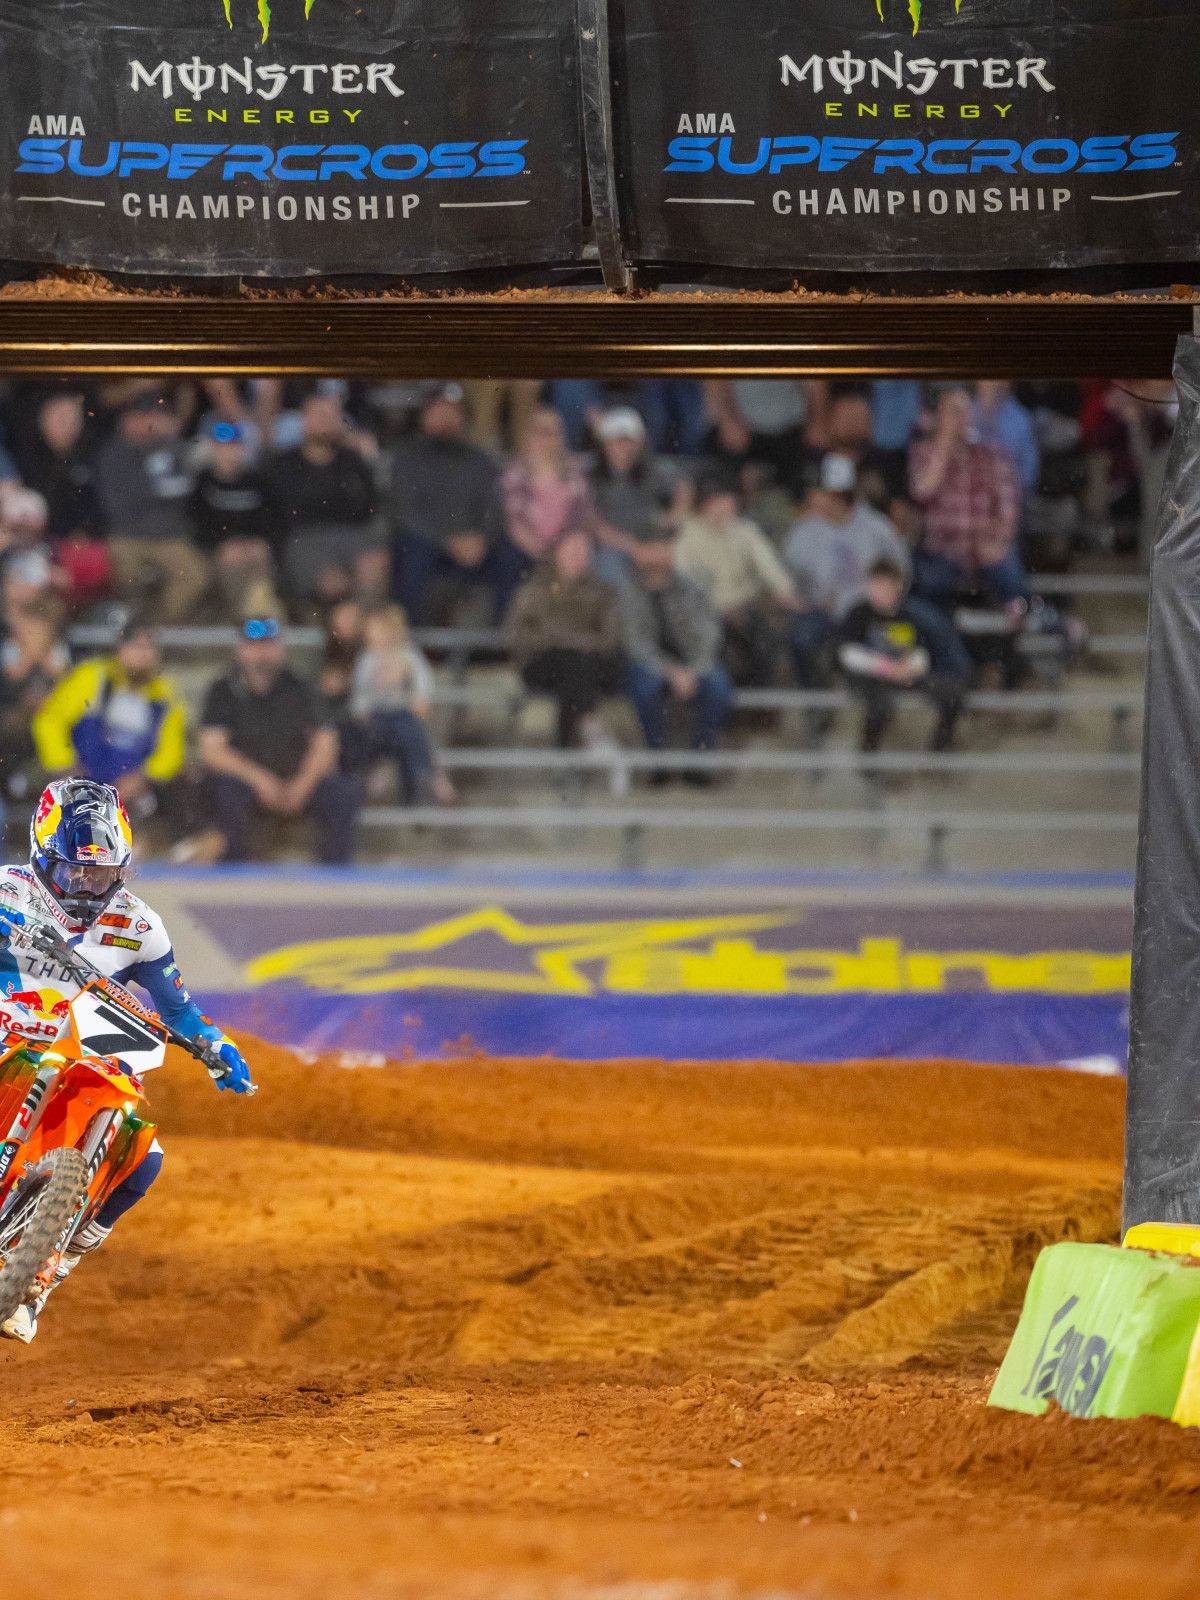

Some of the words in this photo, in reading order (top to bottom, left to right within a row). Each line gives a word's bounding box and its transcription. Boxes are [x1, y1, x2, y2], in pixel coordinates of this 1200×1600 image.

[129, 55, 405, 102] MONSTER
[778, 49, 1056, 95] MONSTER
[27, 114, 86, 137] AMA
[174, 108, 362, 124] ENERGY
[676, 112, 736, 135] AMA
[825, 102, 1013, 119] ENERGY
[14, 138, 529, 181] SUPERCROSS
[662, 131, 1181, 175] SUPERCROSS
[121, 191, 421, 222] CHAMPIONSHIP
[771, 186, 1072, 215] CHAMPIONSHIP
[80, 1004, 161, 1057] 7
